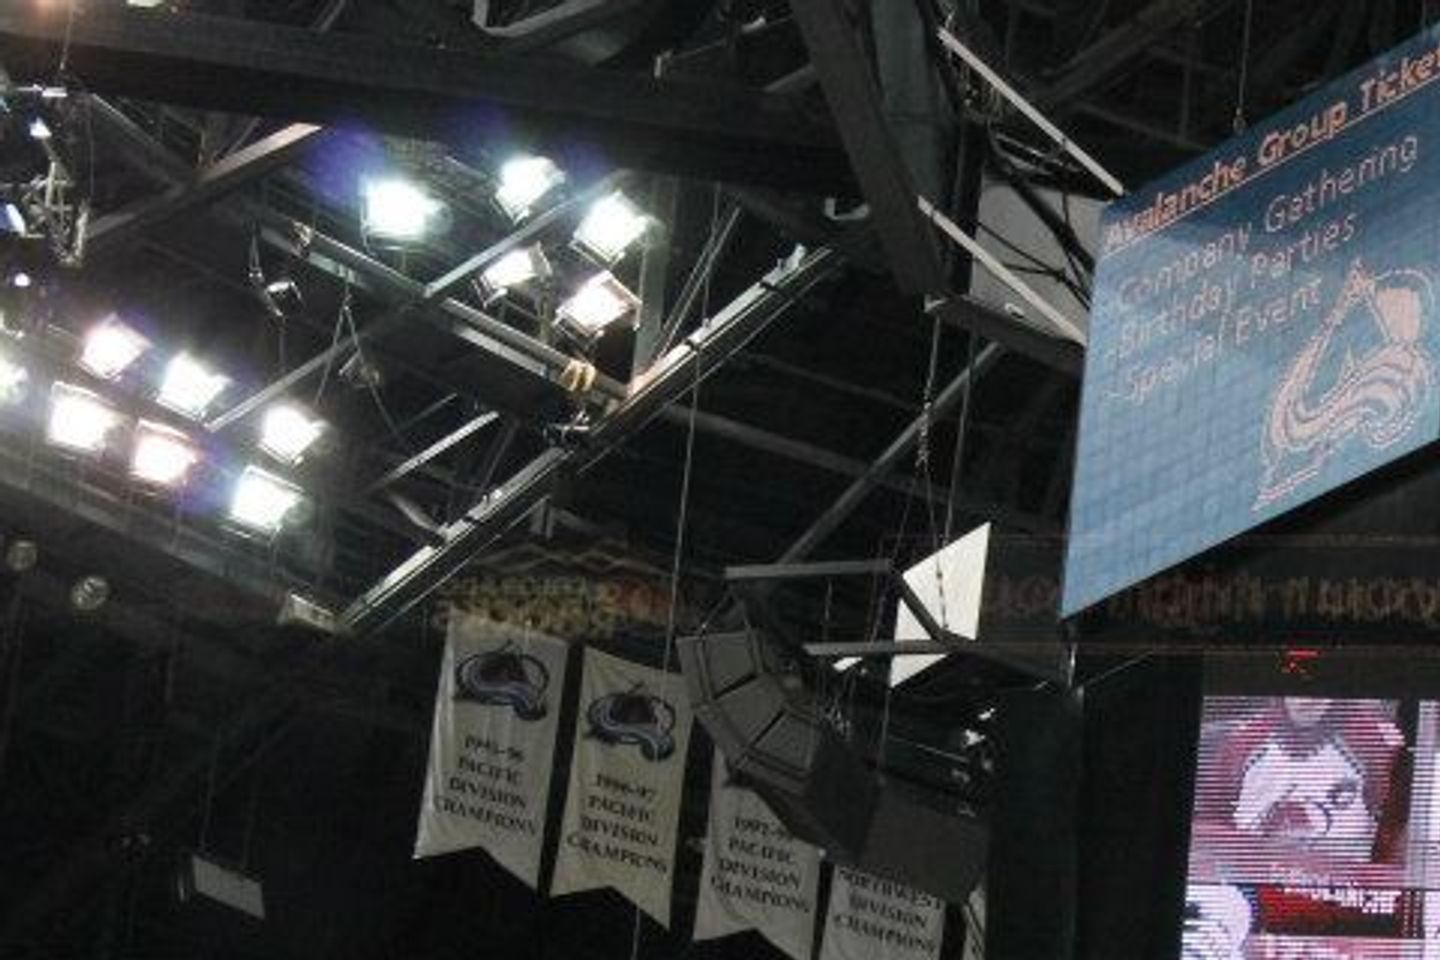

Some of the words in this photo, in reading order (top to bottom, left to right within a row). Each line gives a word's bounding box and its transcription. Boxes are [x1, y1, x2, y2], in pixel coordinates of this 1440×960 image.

[1103, 156, 1247, 246] Avalanche
[1257, 100, 1349, 168] Group
[1263, 137, 1418, 234] Gathering
[1251, 213, 1357, 288] Parties
[450, 777, 526, 809] DIVISION
[580, 816, 658, 845] DIVISION
